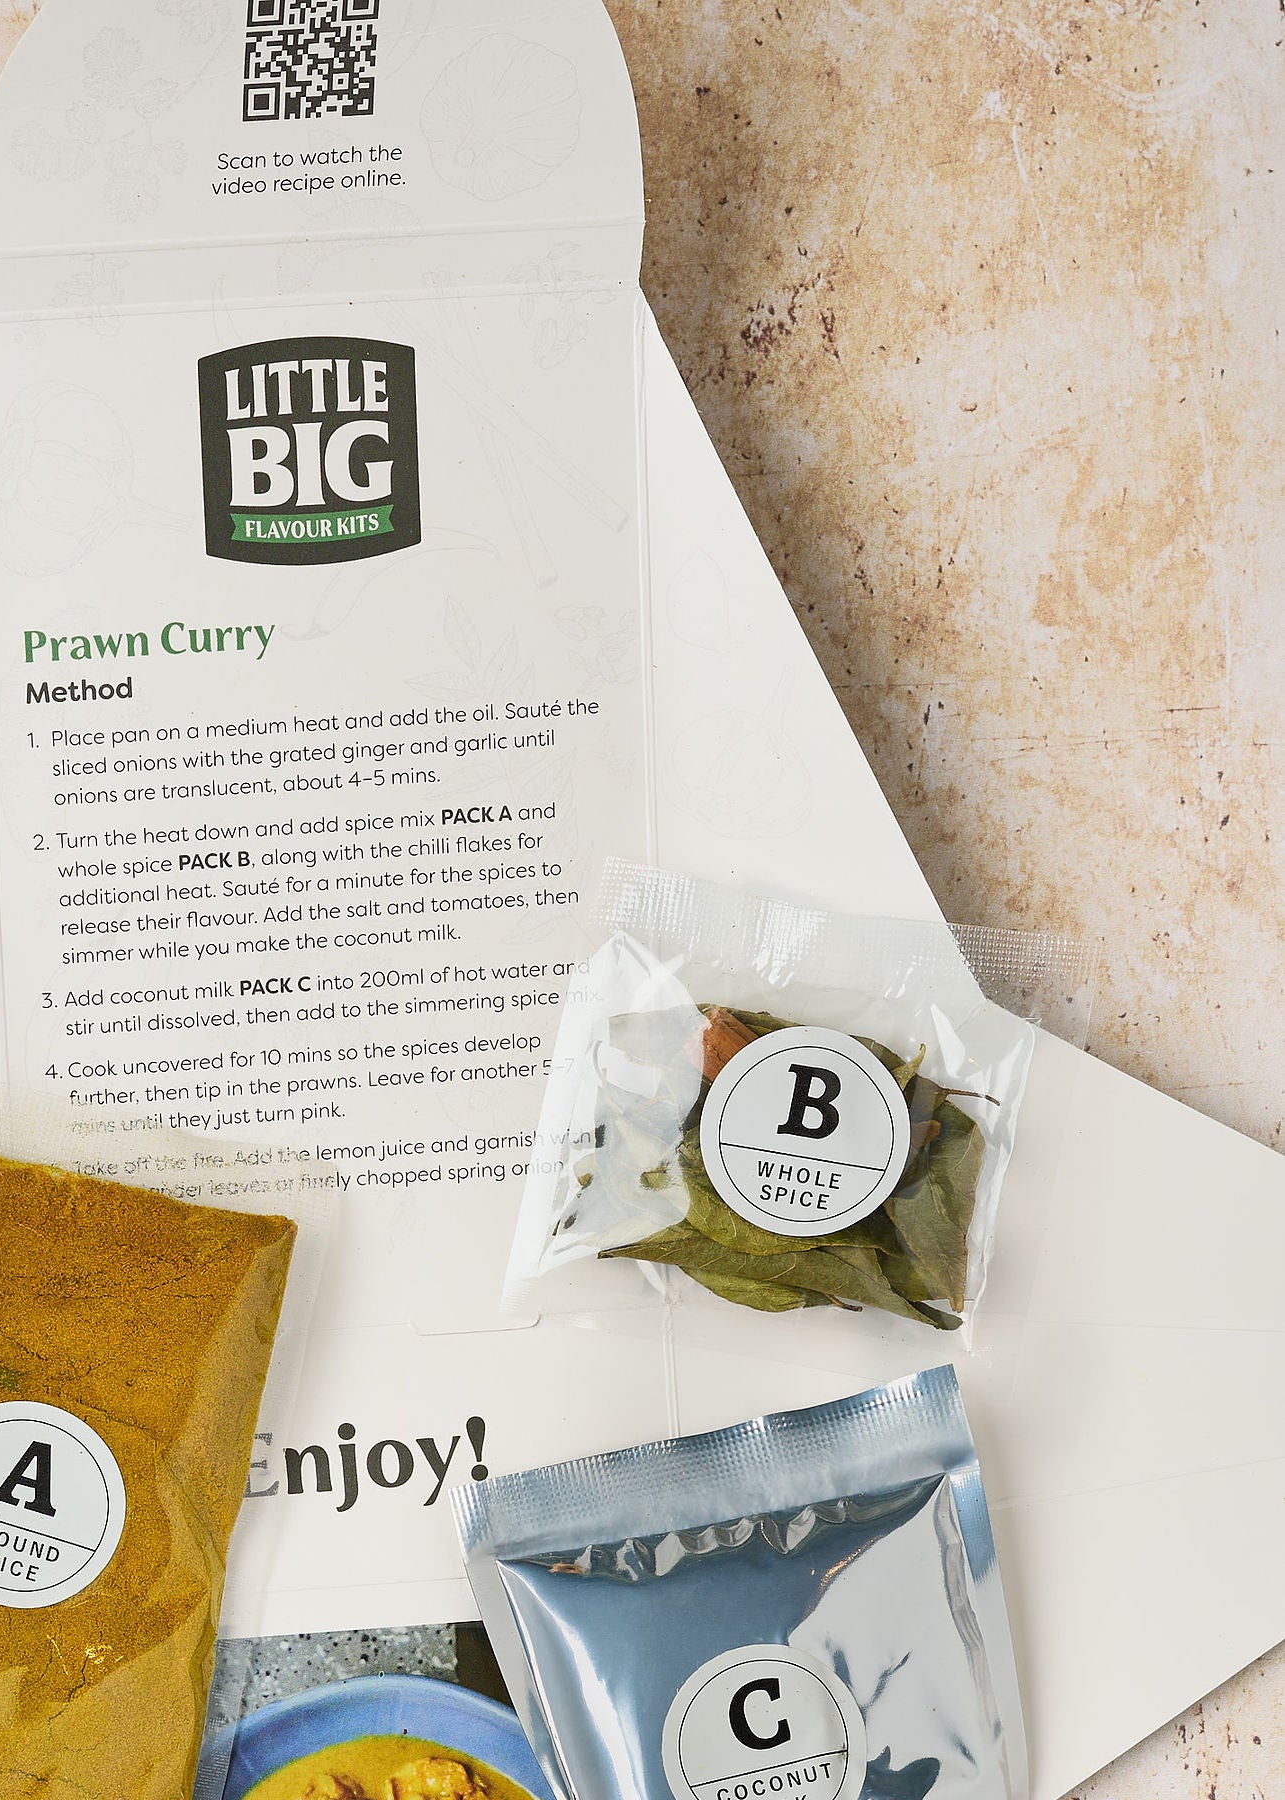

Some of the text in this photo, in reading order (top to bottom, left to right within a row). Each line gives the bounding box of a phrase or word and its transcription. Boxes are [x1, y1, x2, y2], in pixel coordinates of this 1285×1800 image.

[217, 144, 403, 170] Scan to watch the
[211, 169, 406, 195] video recipe online.
[224, 358, 389, 421] LITTLE
[226, 419, 394, 507] BIG
[245, 513, 380, 539] FLAVOUR KITS
[23, 621, 276, 663] Prawn Curry
[26, 676, 133, 705] Method
[26, 698, 600, 749] 1. Place pan on a medium heat and add the oil. Sauté the
[52, 728, 555, 777] sliced onions with the grated ginger and garlic until
[54, 787, 118, 806] onions
[123, 787, 156, 802] are
[161, 778, 277, 800] translucent,
[282, 773, 343, 792] about
[391, 767, 441, 785] mins.
[57, 832, 544, 879] whole spice PACK B, along with the chilli flakes for
[41, 992, 58, 1009] 3.
[64, 988, 104, 1008] Add
[110, 985, 190, 1005] coconut
[195, 981, 235, 999] milk
[239, 977, 294, 997] PACK
[297, 975, 312, 993] C
[317, 975, 354, 991] into
[359, 967, 424, 989] 200ml
[430, 966, 451, 984] of
[454, 965, 487, 982] hot
[490, 963, 548, 980] water
[776, 1063, 842, 1140] B
[758, 1160, 842, 1190] WHOLE
[759, 1184, 830, 1211] SPICE
[728, 1677, 791, 1751] C
